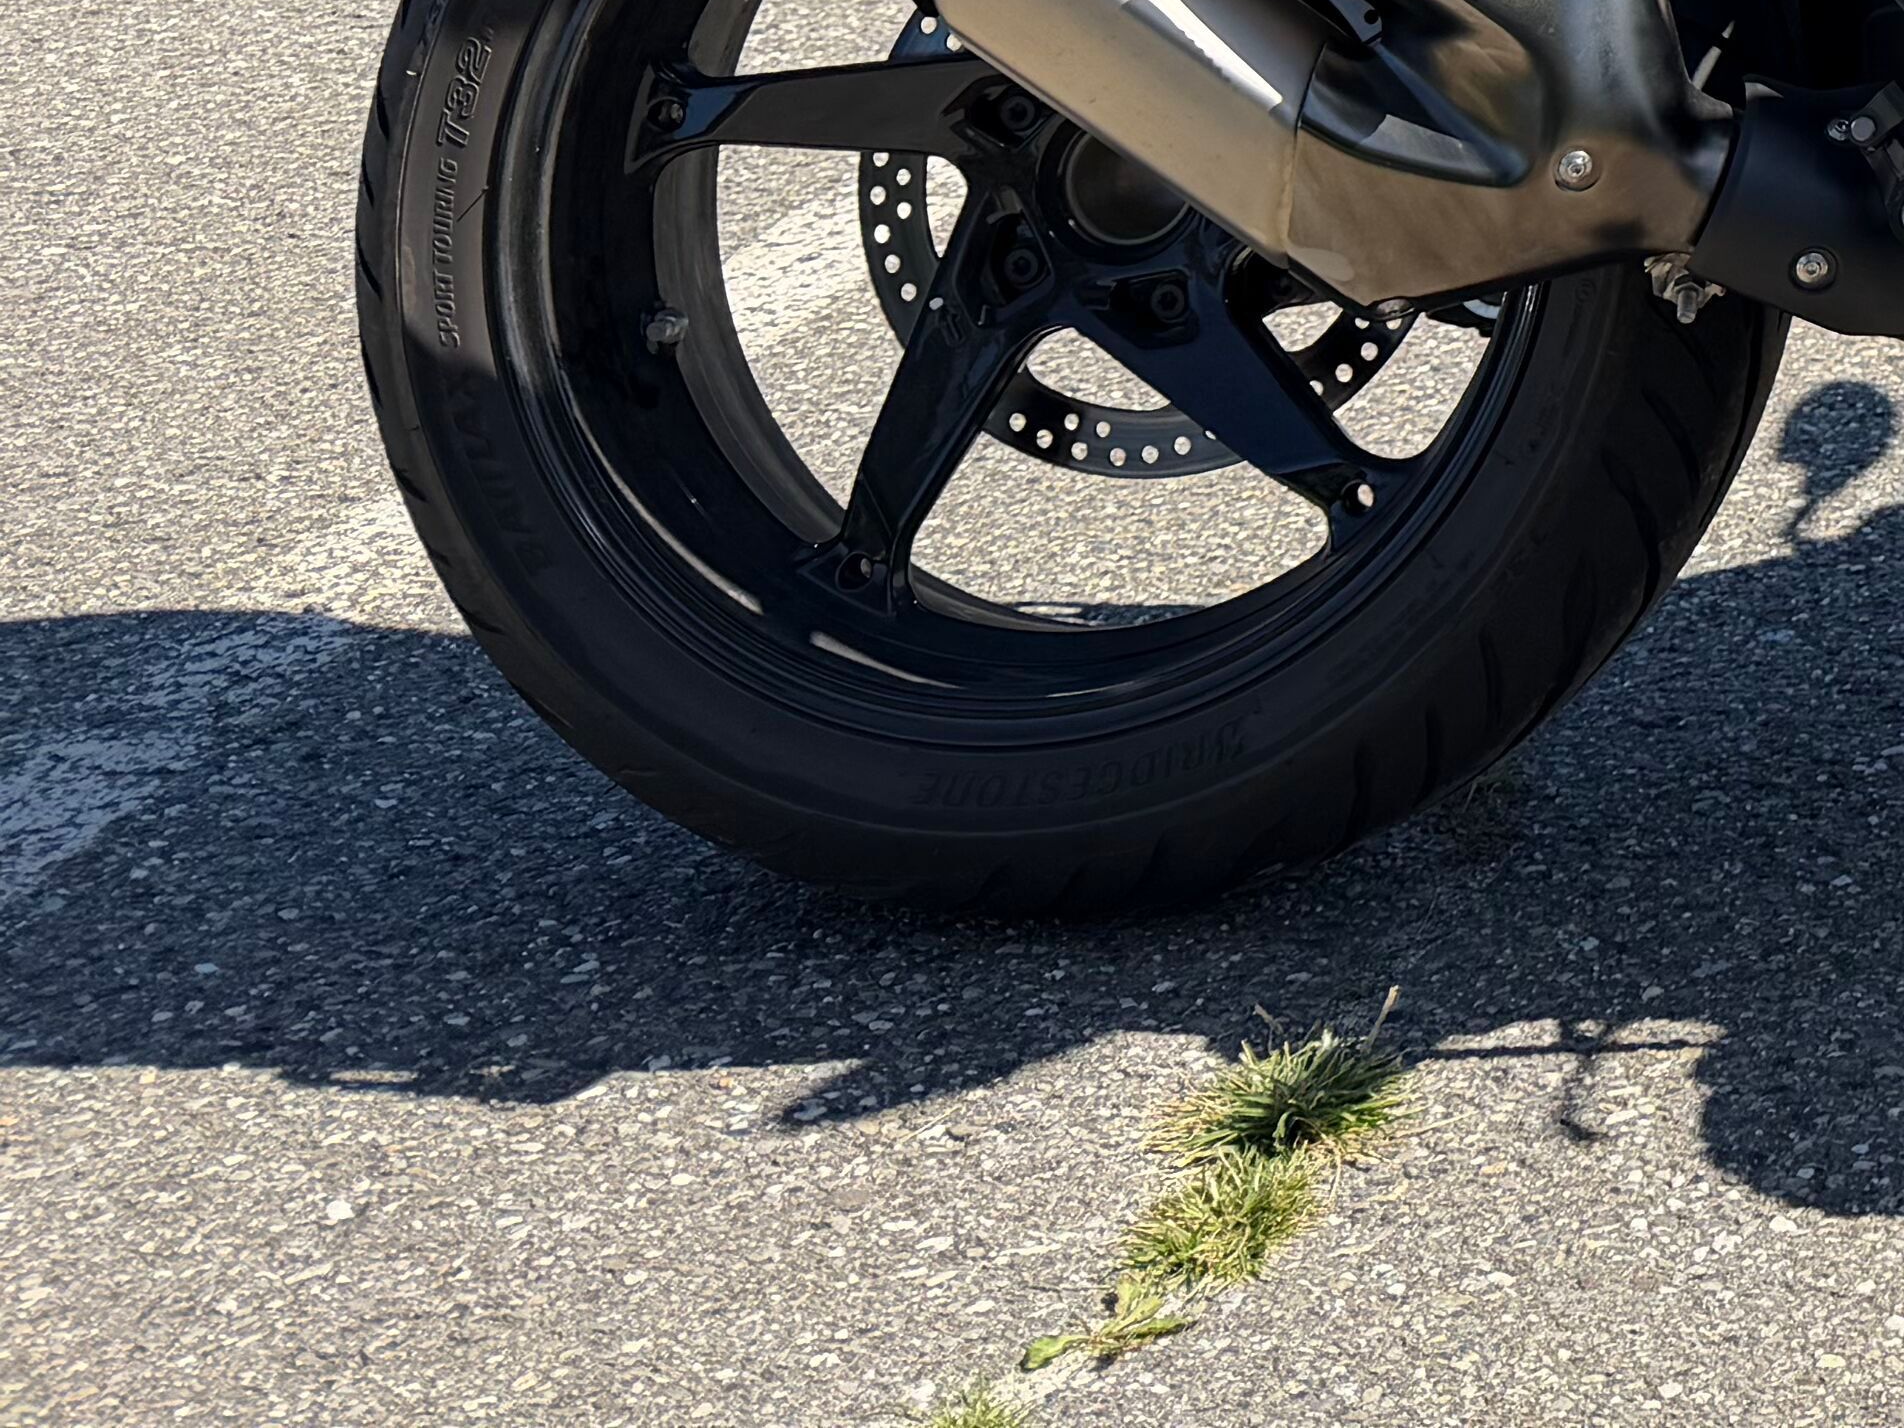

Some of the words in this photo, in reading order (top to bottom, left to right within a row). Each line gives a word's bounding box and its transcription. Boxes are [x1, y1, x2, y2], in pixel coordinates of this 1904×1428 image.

[431, 157, 459, 266] TOURING
[432, 271, 461, 349] SPORT
[906, 714, 1250, 808] BRIDGESTONE
